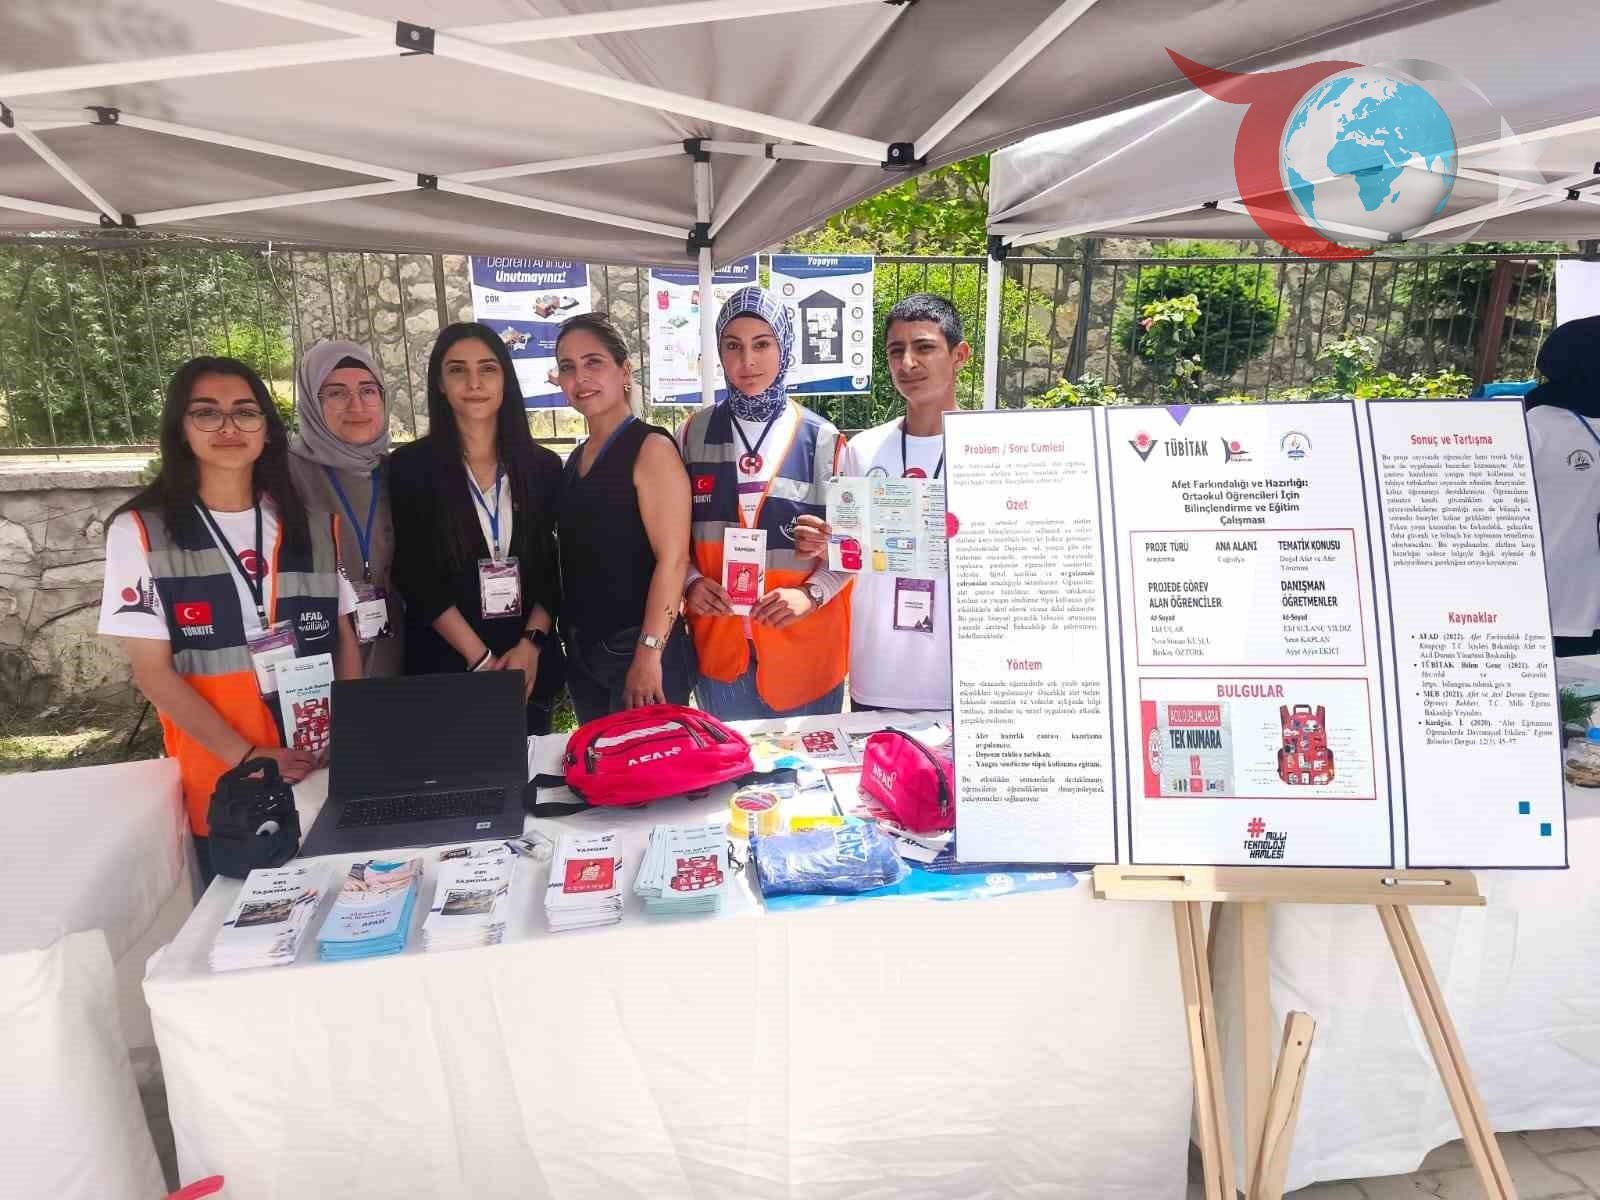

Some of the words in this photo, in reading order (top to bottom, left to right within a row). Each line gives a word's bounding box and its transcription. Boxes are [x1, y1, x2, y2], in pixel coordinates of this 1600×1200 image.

[496, 272, 567, 285] Unutmayınız!
[1411, 434, 1438, 446] Sonuç
[1440, 435, 1451, 445] ve
[1453, 434, 1493, 446] Tartışma
[965, 445, 999, 455] Problem
[1008, 443, 1028, 455] Soru
[1164, 437, 1208, 457] TÜBİTAK
[1171, 480, 1191, 489] Afet
[1193, 480, 1249, 490] Farkındalığı
[1265, 478, 1308, 490] Hazırlığı:
[1182, 492, 1223, 501] Ortaokul
[1225, 491, 1278, 502] Öğrencileri
[1280, 490, 1300, 501] İçin
[1006, 497, 1028, 510] Özet
[1184, 503, 1253, 514] Bilinçlendirme
[1255, 504, 1266, 512] ve
[1269, 503, 1299, 514] Eğitim
[1220, 515, 1265, 526] Çalışması
[1145, 542, 1167, 552] PROJE
[1215, 541, 1231, 551] ANA
[1232, 541, 1258, 551] ALANI
[1278, 538, 1310, 550] TEMATİK
[1311, 540, 1340, 550] KONUSU
[1148, 582, 1182, 592] PROJEDE
[1183, 579, 1208, 592] GÖREV
[1281, 580, 1326, 593] DANIŞMAN
[1149, 598, 1169, 608] ALAN
[1170, 594, 1222, 608] ÖĞRENCİLER
[1282, 594, 1338, 607] ÖĞRETMENLER
[300, 611, 323, 622] AFAD
[1448, 611, 1498, 625] Kaynaklar
[181, 624, 214, 637] TÜRKİYE
[1006, 659, 1042, 671] Yöntem
[1217, 684, 1284, 698] BULGULAR
[1170, 730, 1186, 749] TEK
[1187, 730, 1222, 748] NUMARA
